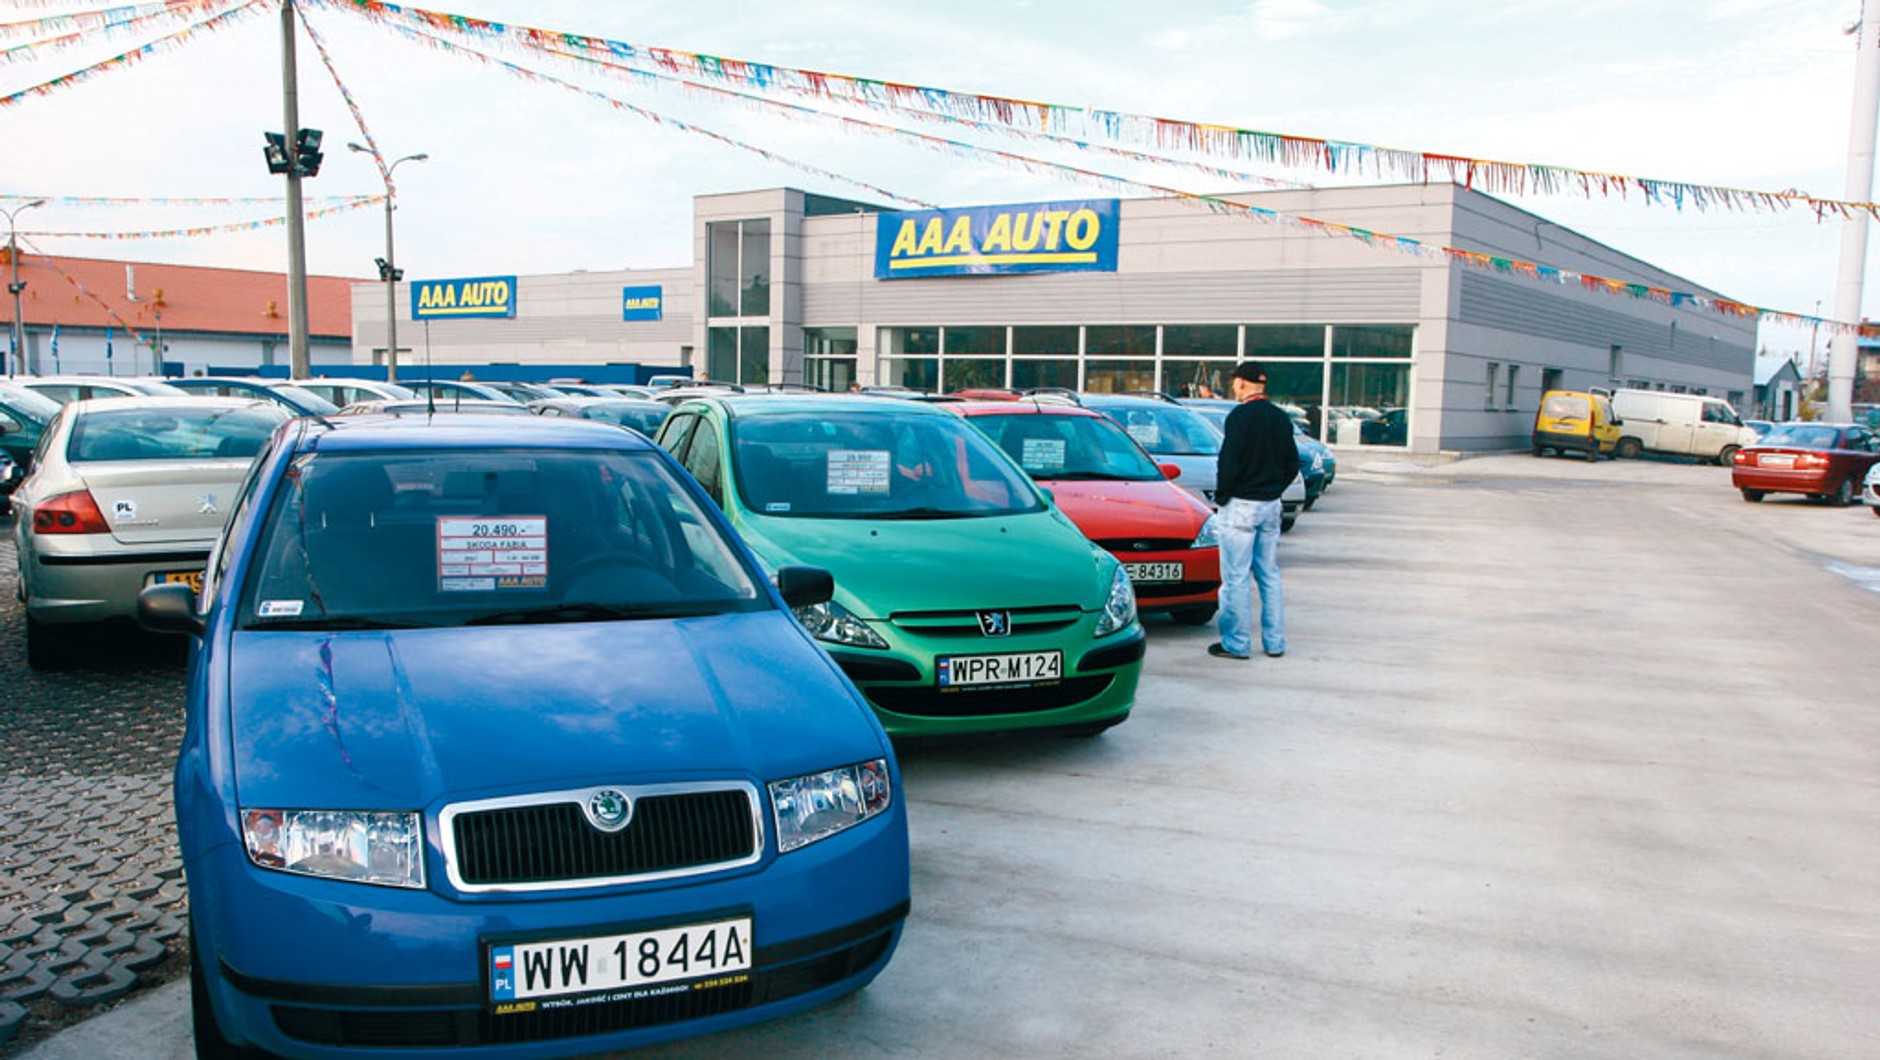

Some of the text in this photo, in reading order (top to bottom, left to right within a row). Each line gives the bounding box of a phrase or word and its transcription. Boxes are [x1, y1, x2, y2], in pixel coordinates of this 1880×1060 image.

[890, 208, 1101, 257] AAA AUTO
[418, 280, 509, 308] AAA AUTO
[117, 502, 133, 512] PL
[1138, 564, 1180, 579] 84316
[952, 654, 1059, 682] WPR M124
[523, 926, 744, 990] WW 1844A
[495, 978, 512, 991] PL
